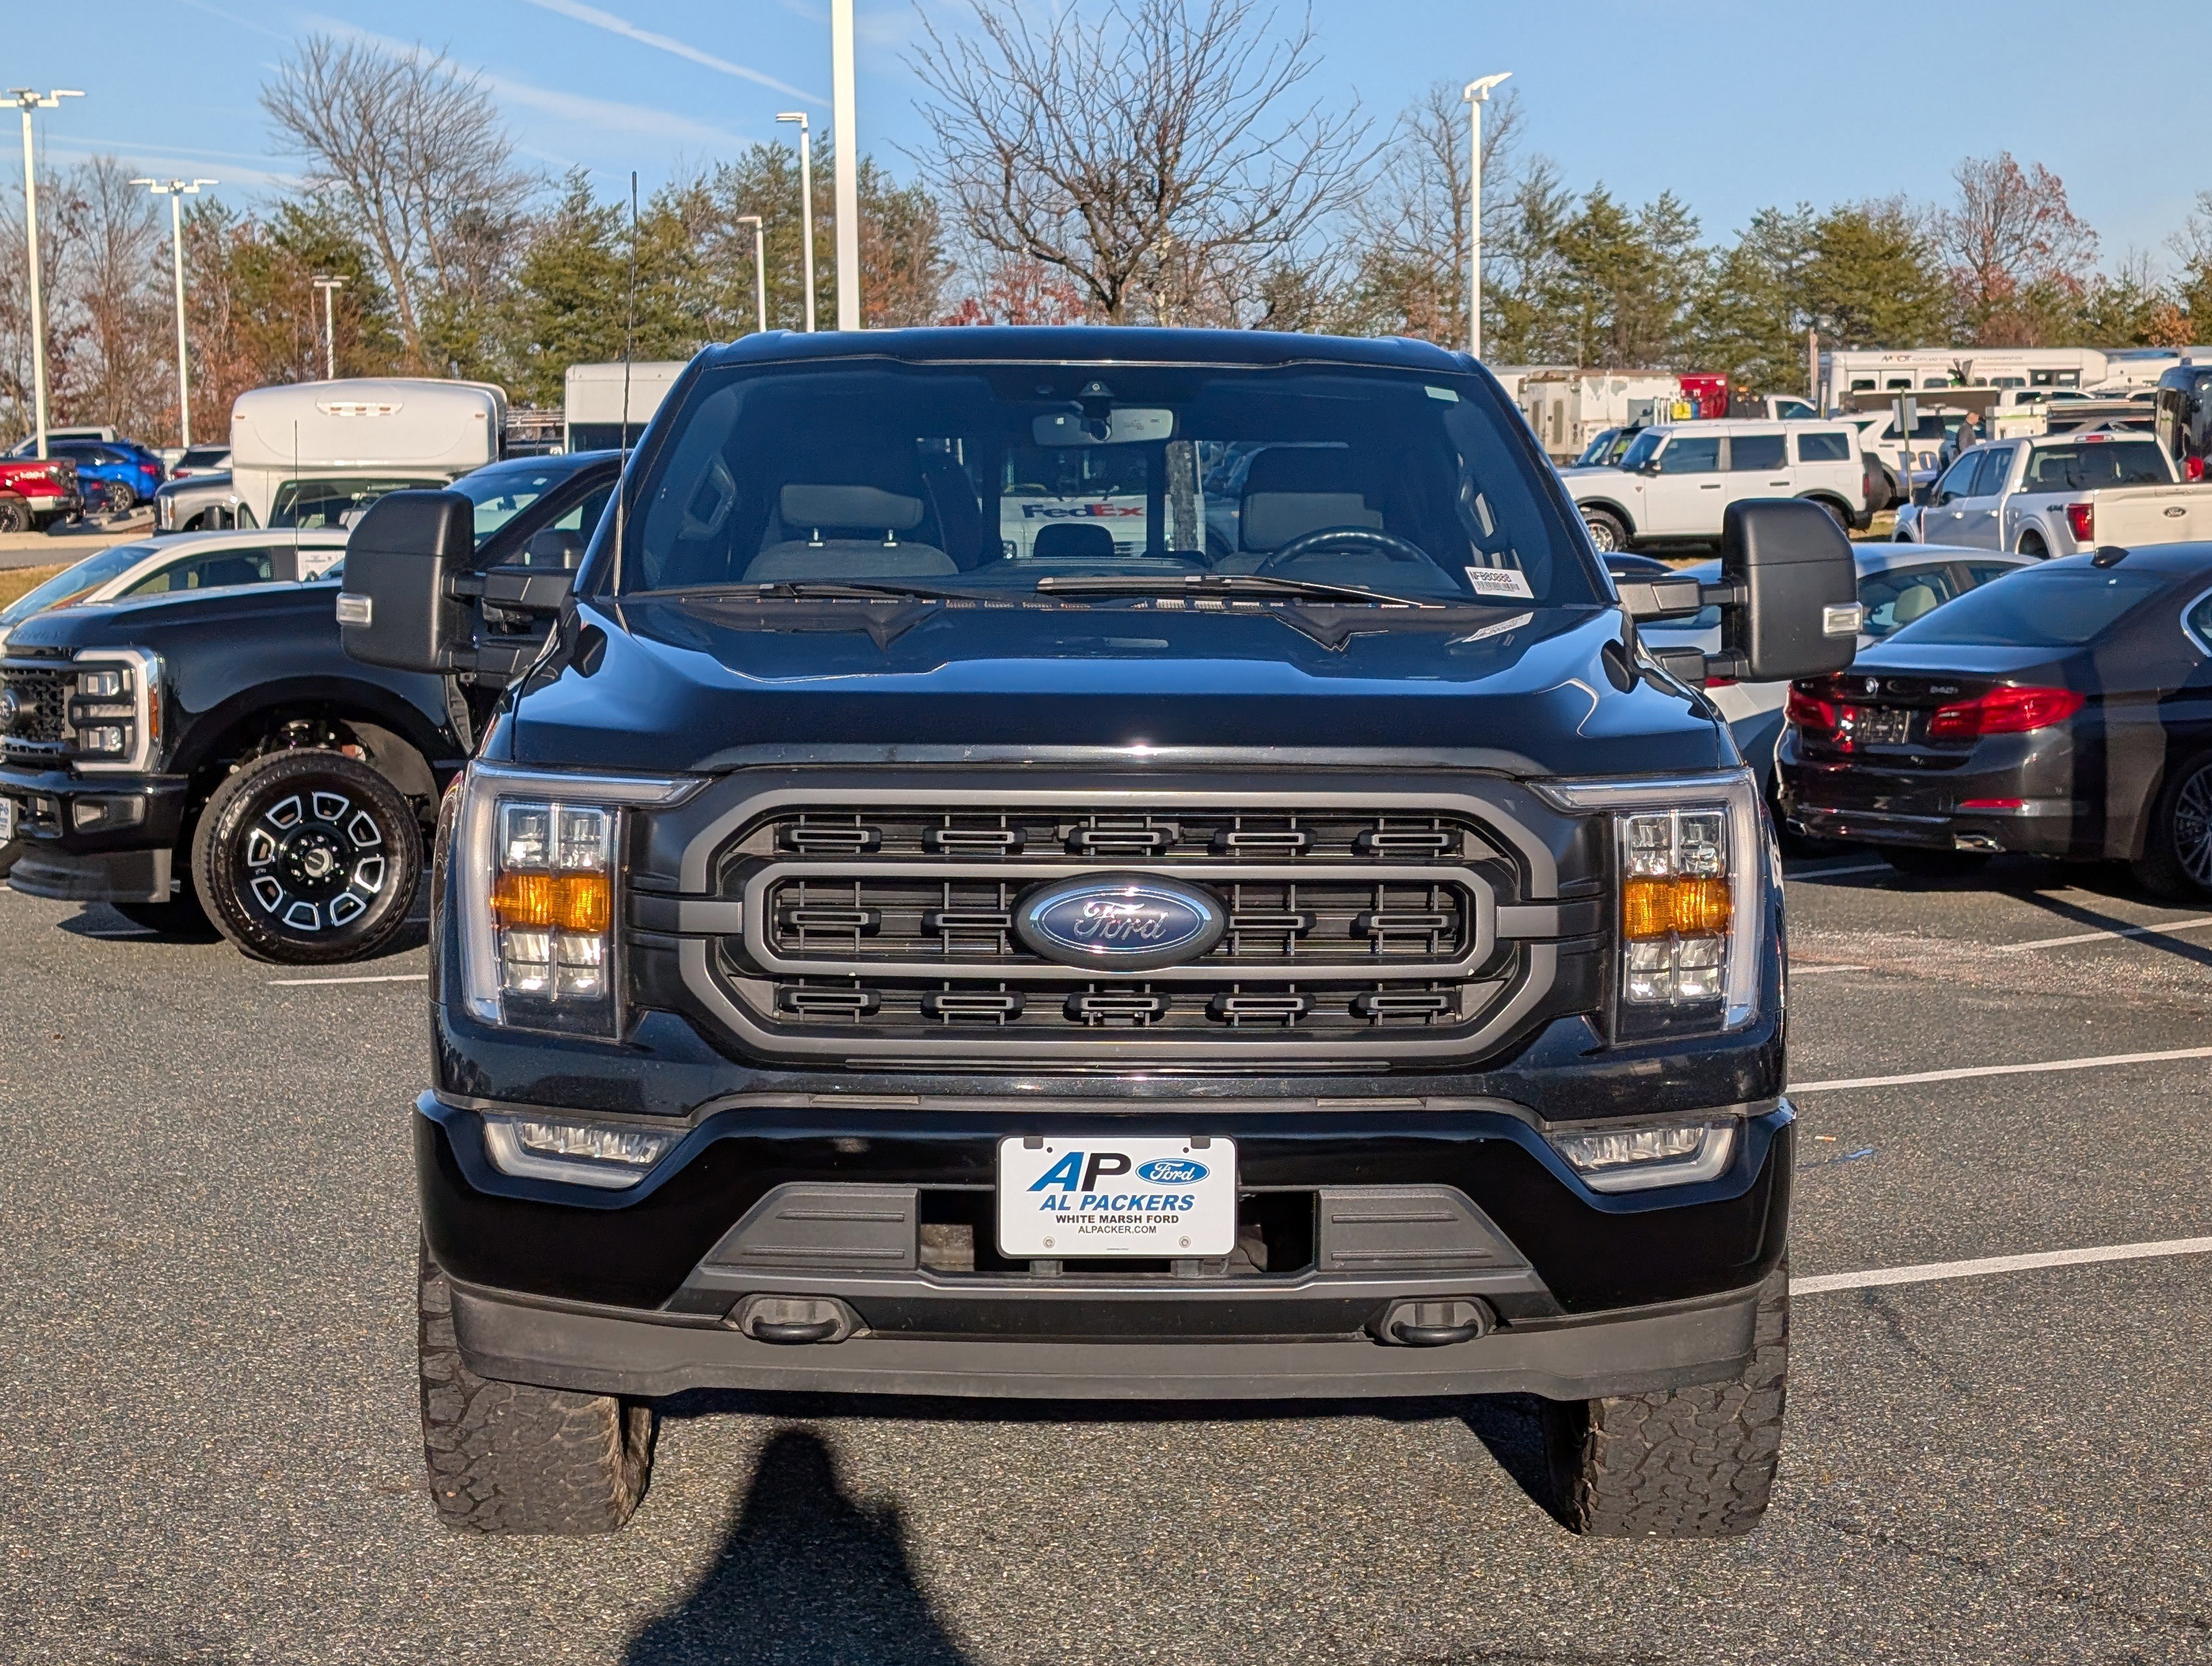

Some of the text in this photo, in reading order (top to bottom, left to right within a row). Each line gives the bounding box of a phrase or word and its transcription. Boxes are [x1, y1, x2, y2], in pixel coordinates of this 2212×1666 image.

[1021, 503, 1144, 518] FedEx
[1073, 901, 1169, 940] Ford
[1026, 1152, 1131, 1191] AP
[1150, 1162, 1195, 1181] Ford
[1039, 1195, 1195, 1211] AL PACKERS
[1056, 1215, 1179, 1223] WHITE MARSH FORD
[1078, 1226, 1156, 1234] ALPACKER.COM
